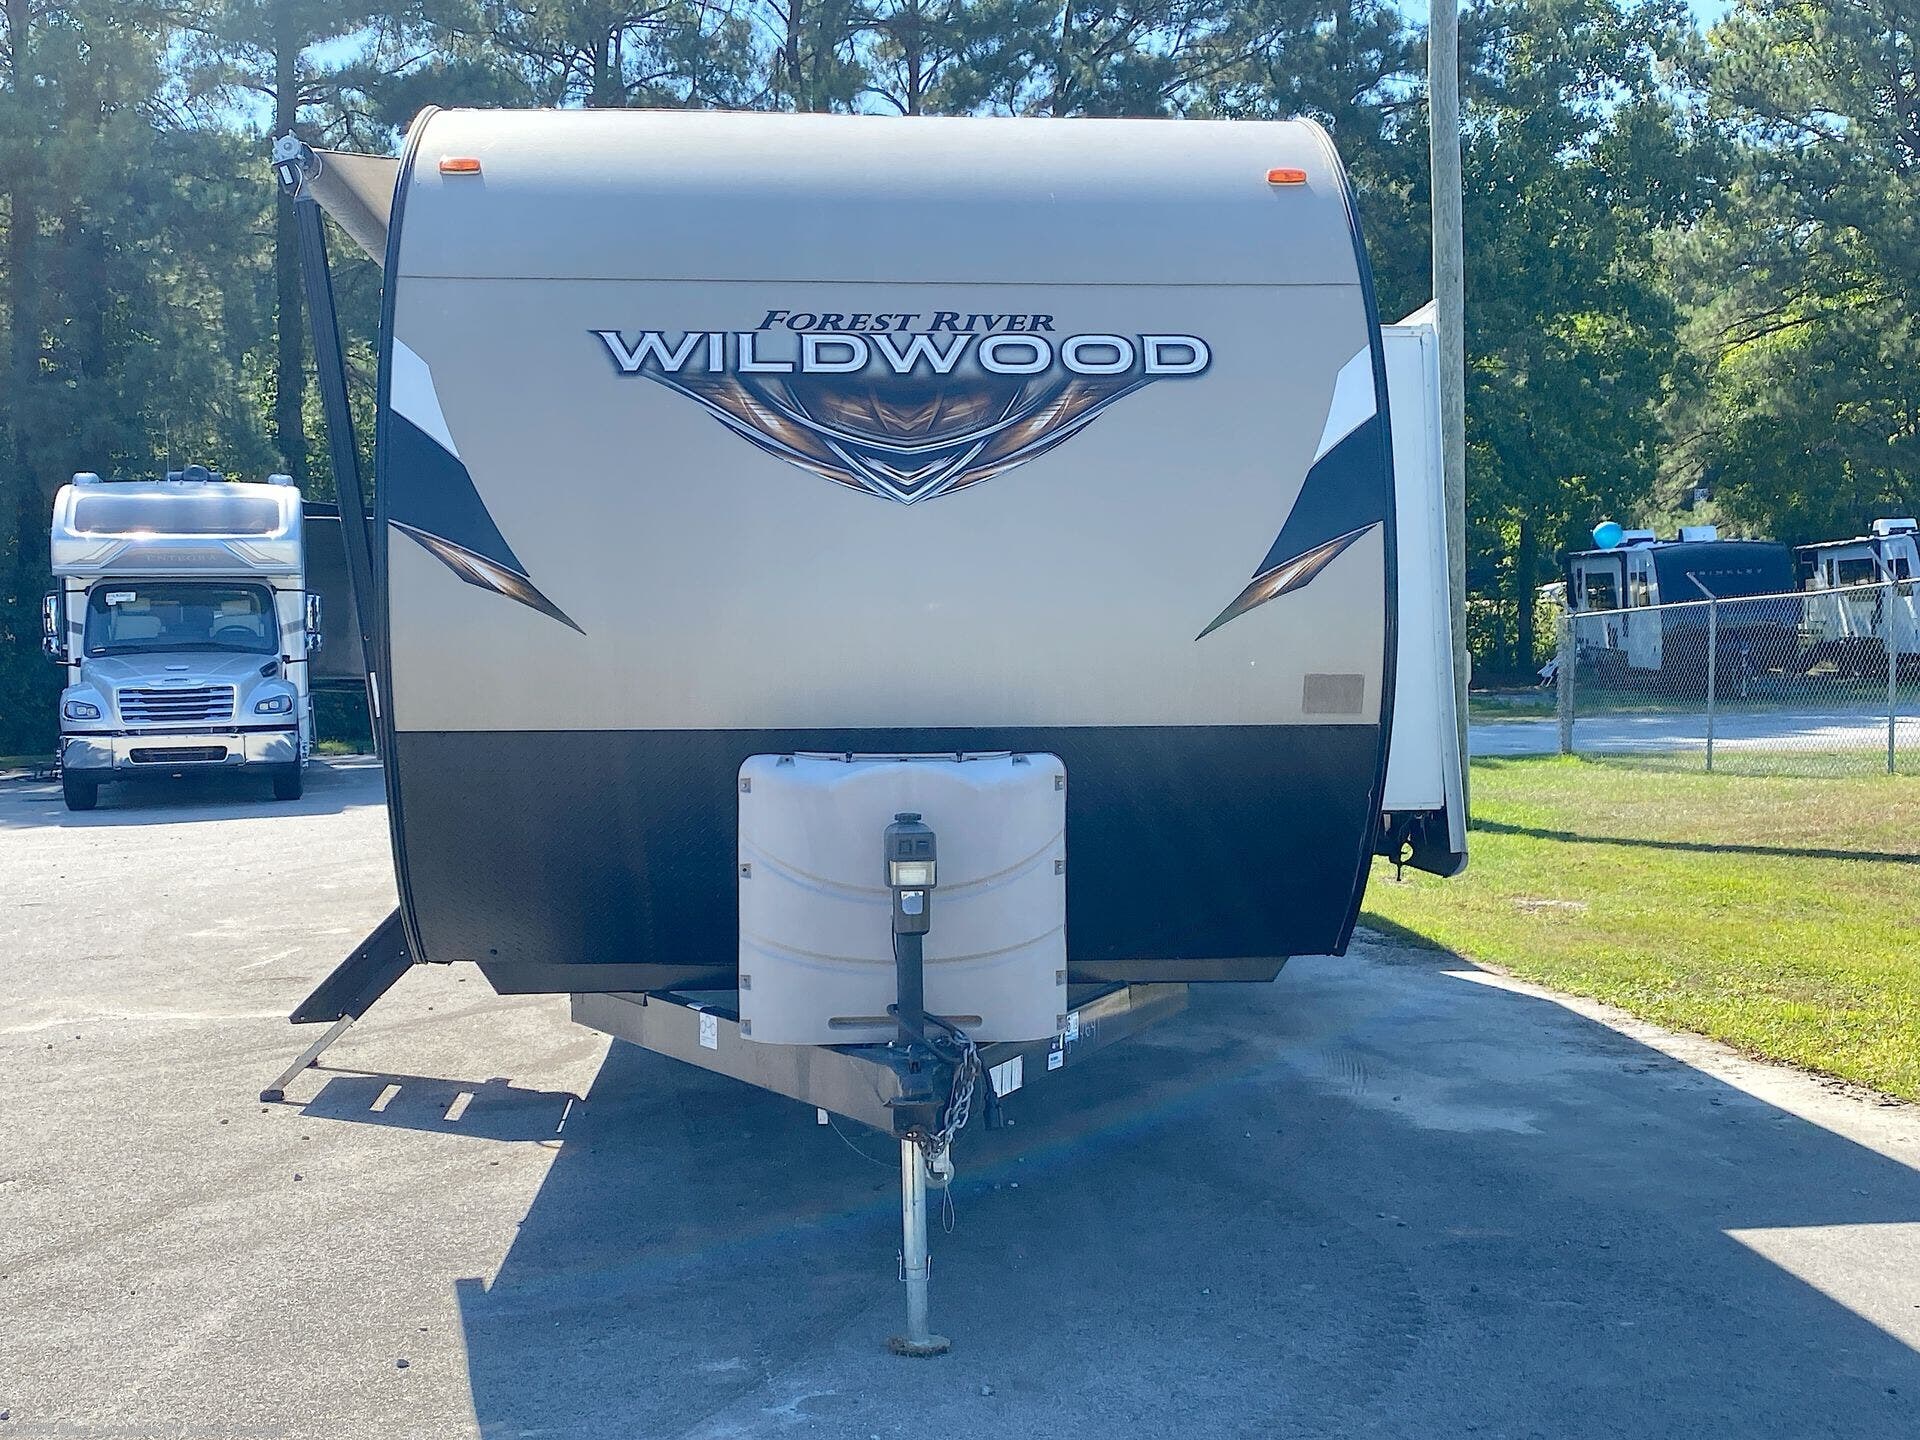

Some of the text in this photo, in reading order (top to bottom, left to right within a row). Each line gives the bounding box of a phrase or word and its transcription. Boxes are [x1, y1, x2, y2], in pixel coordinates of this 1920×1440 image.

[760, 310, 1055, 332] FOREST RIVER
[589, 329, 1212, 376] WILDWOOD
